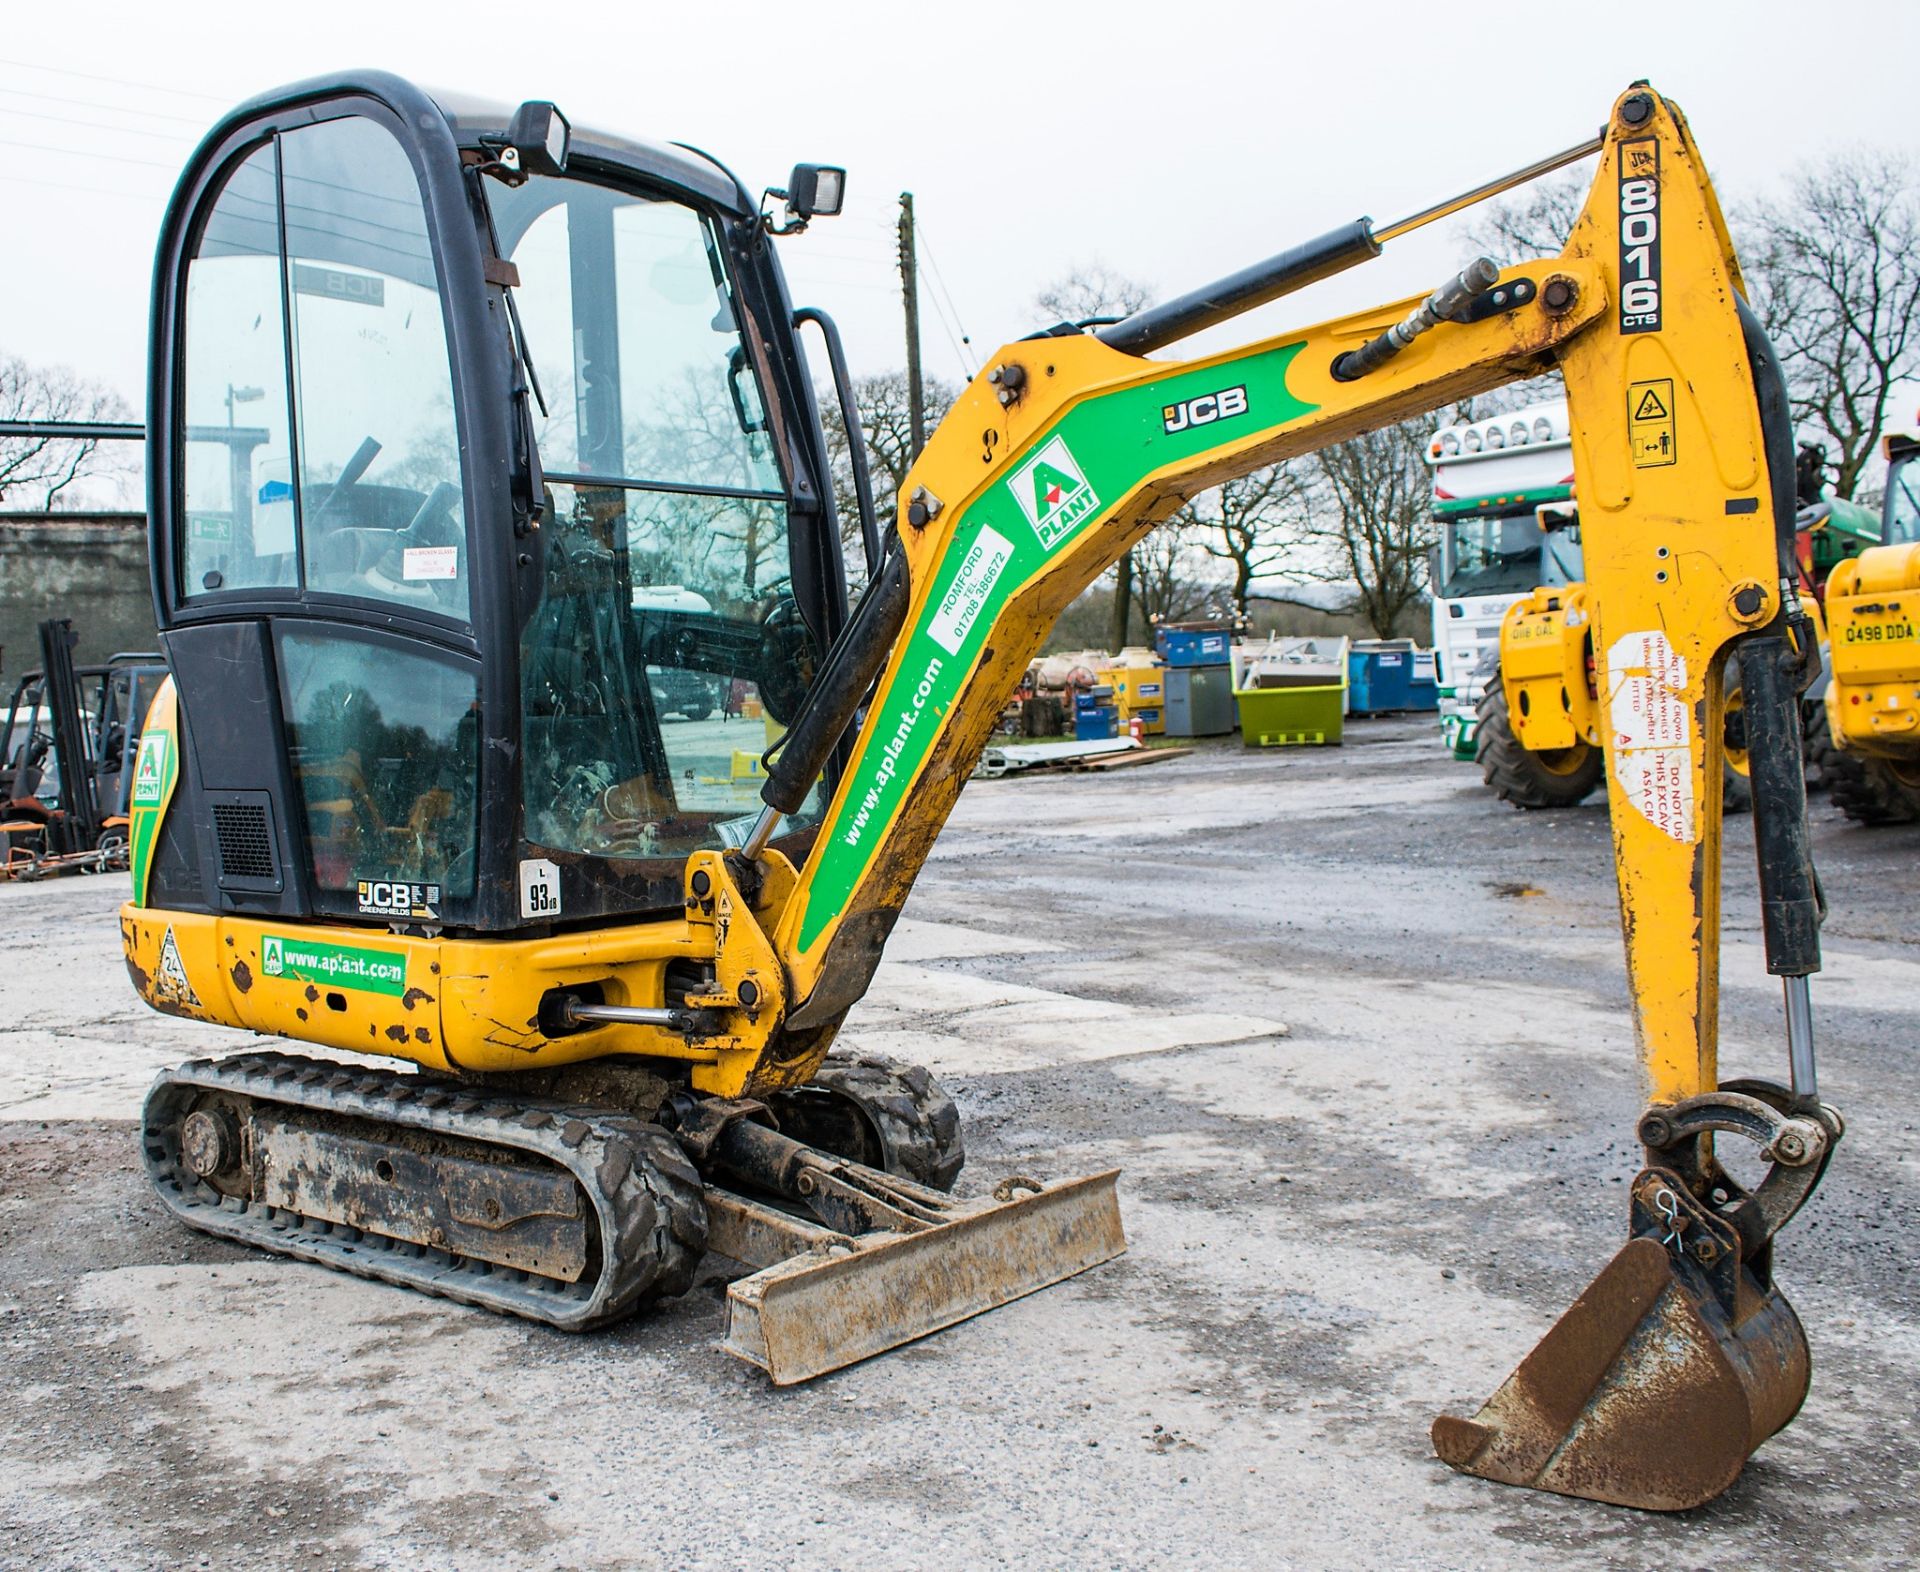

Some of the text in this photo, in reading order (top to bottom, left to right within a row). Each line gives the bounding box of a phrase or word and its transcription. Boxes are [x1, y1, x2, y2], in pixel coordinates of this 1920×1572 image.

[1621, 179, 1659, 314] 8016
[1622, 313, 1658, 327] CTS
[1163, 387, 1248, 432] JCB
[1038, 487, 1094, 545] PLANT
[942, 546, 984, 616] ROMFORD
[954, 551, 1005, 638] 01708 386672
[1886, 623, 1913, 640] DDA
[1631, 680, 1640, 712] FITTED
[1661, 705, 1669, 740] WHILST
[844, 657, 944, 847] www.aplant.com
[1642, 770, 1653, 786] AS
[1655, 752, 1666, 782] THIS
[1670, 767, 1680, 786] DO
[1643, 788, 1653, 798] A
[1671, 790, 1682, 817] NOT
[539, 868, 546, 878] L
[358, 881, 412, 909] JCB
[530, 883, 549, 912] 93
[358, 905, 411, 917] GREENSHIELDS
